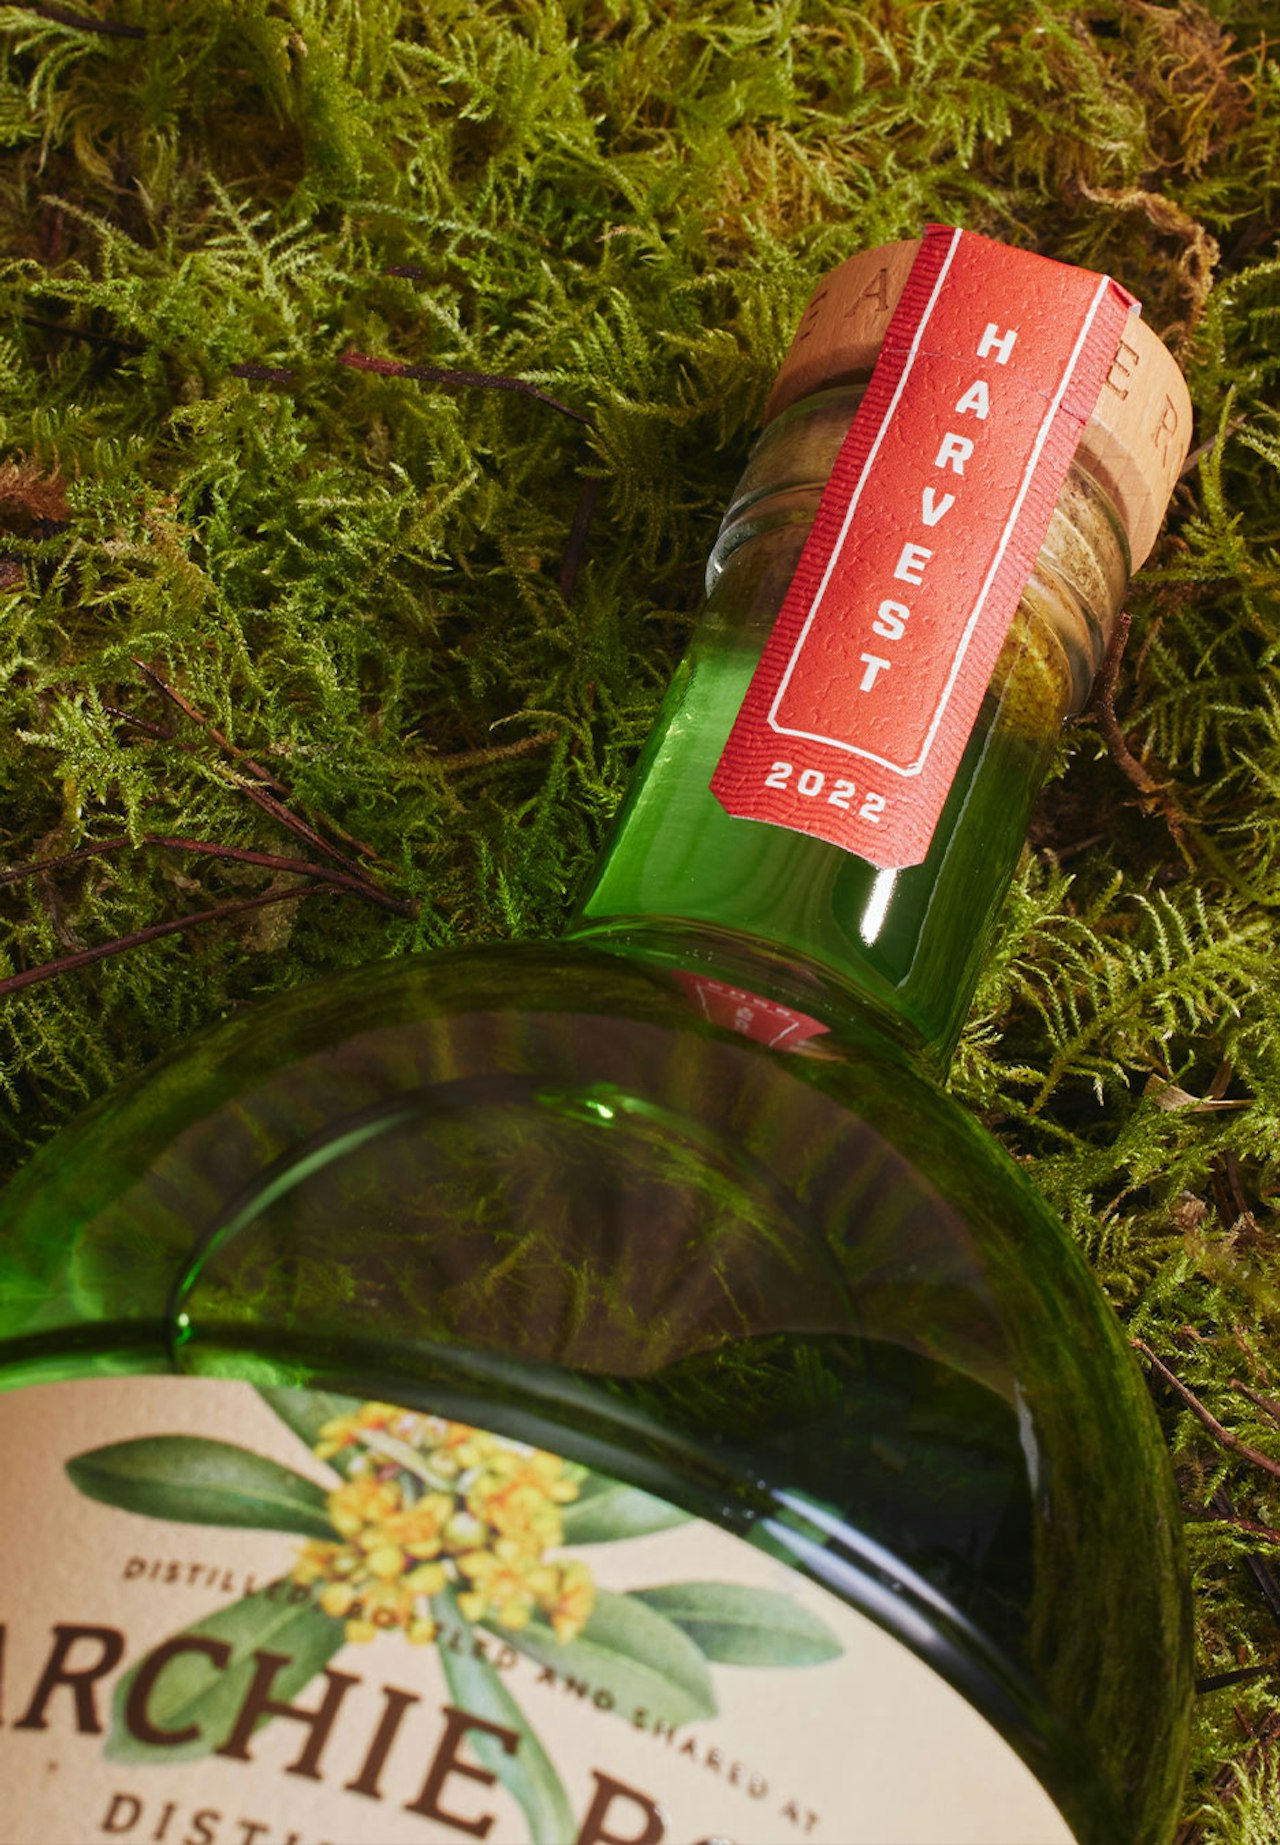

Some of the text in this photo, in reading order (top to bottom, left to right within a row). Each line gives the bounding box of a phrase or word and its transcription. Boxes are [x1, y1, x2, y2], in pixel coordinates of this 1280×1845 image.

[859, 322, 1018, 694] HARVEST
[764, 760, 887, 824] 2022
[0, 1621, 521, 1840] RCHIE
[535, 1665, 616, 1711] AND
[630, 1705, 769, 1799] SHARED
[778, 1798, 820, 1836] AT
[99, 1792, 336, 1845] DIST
